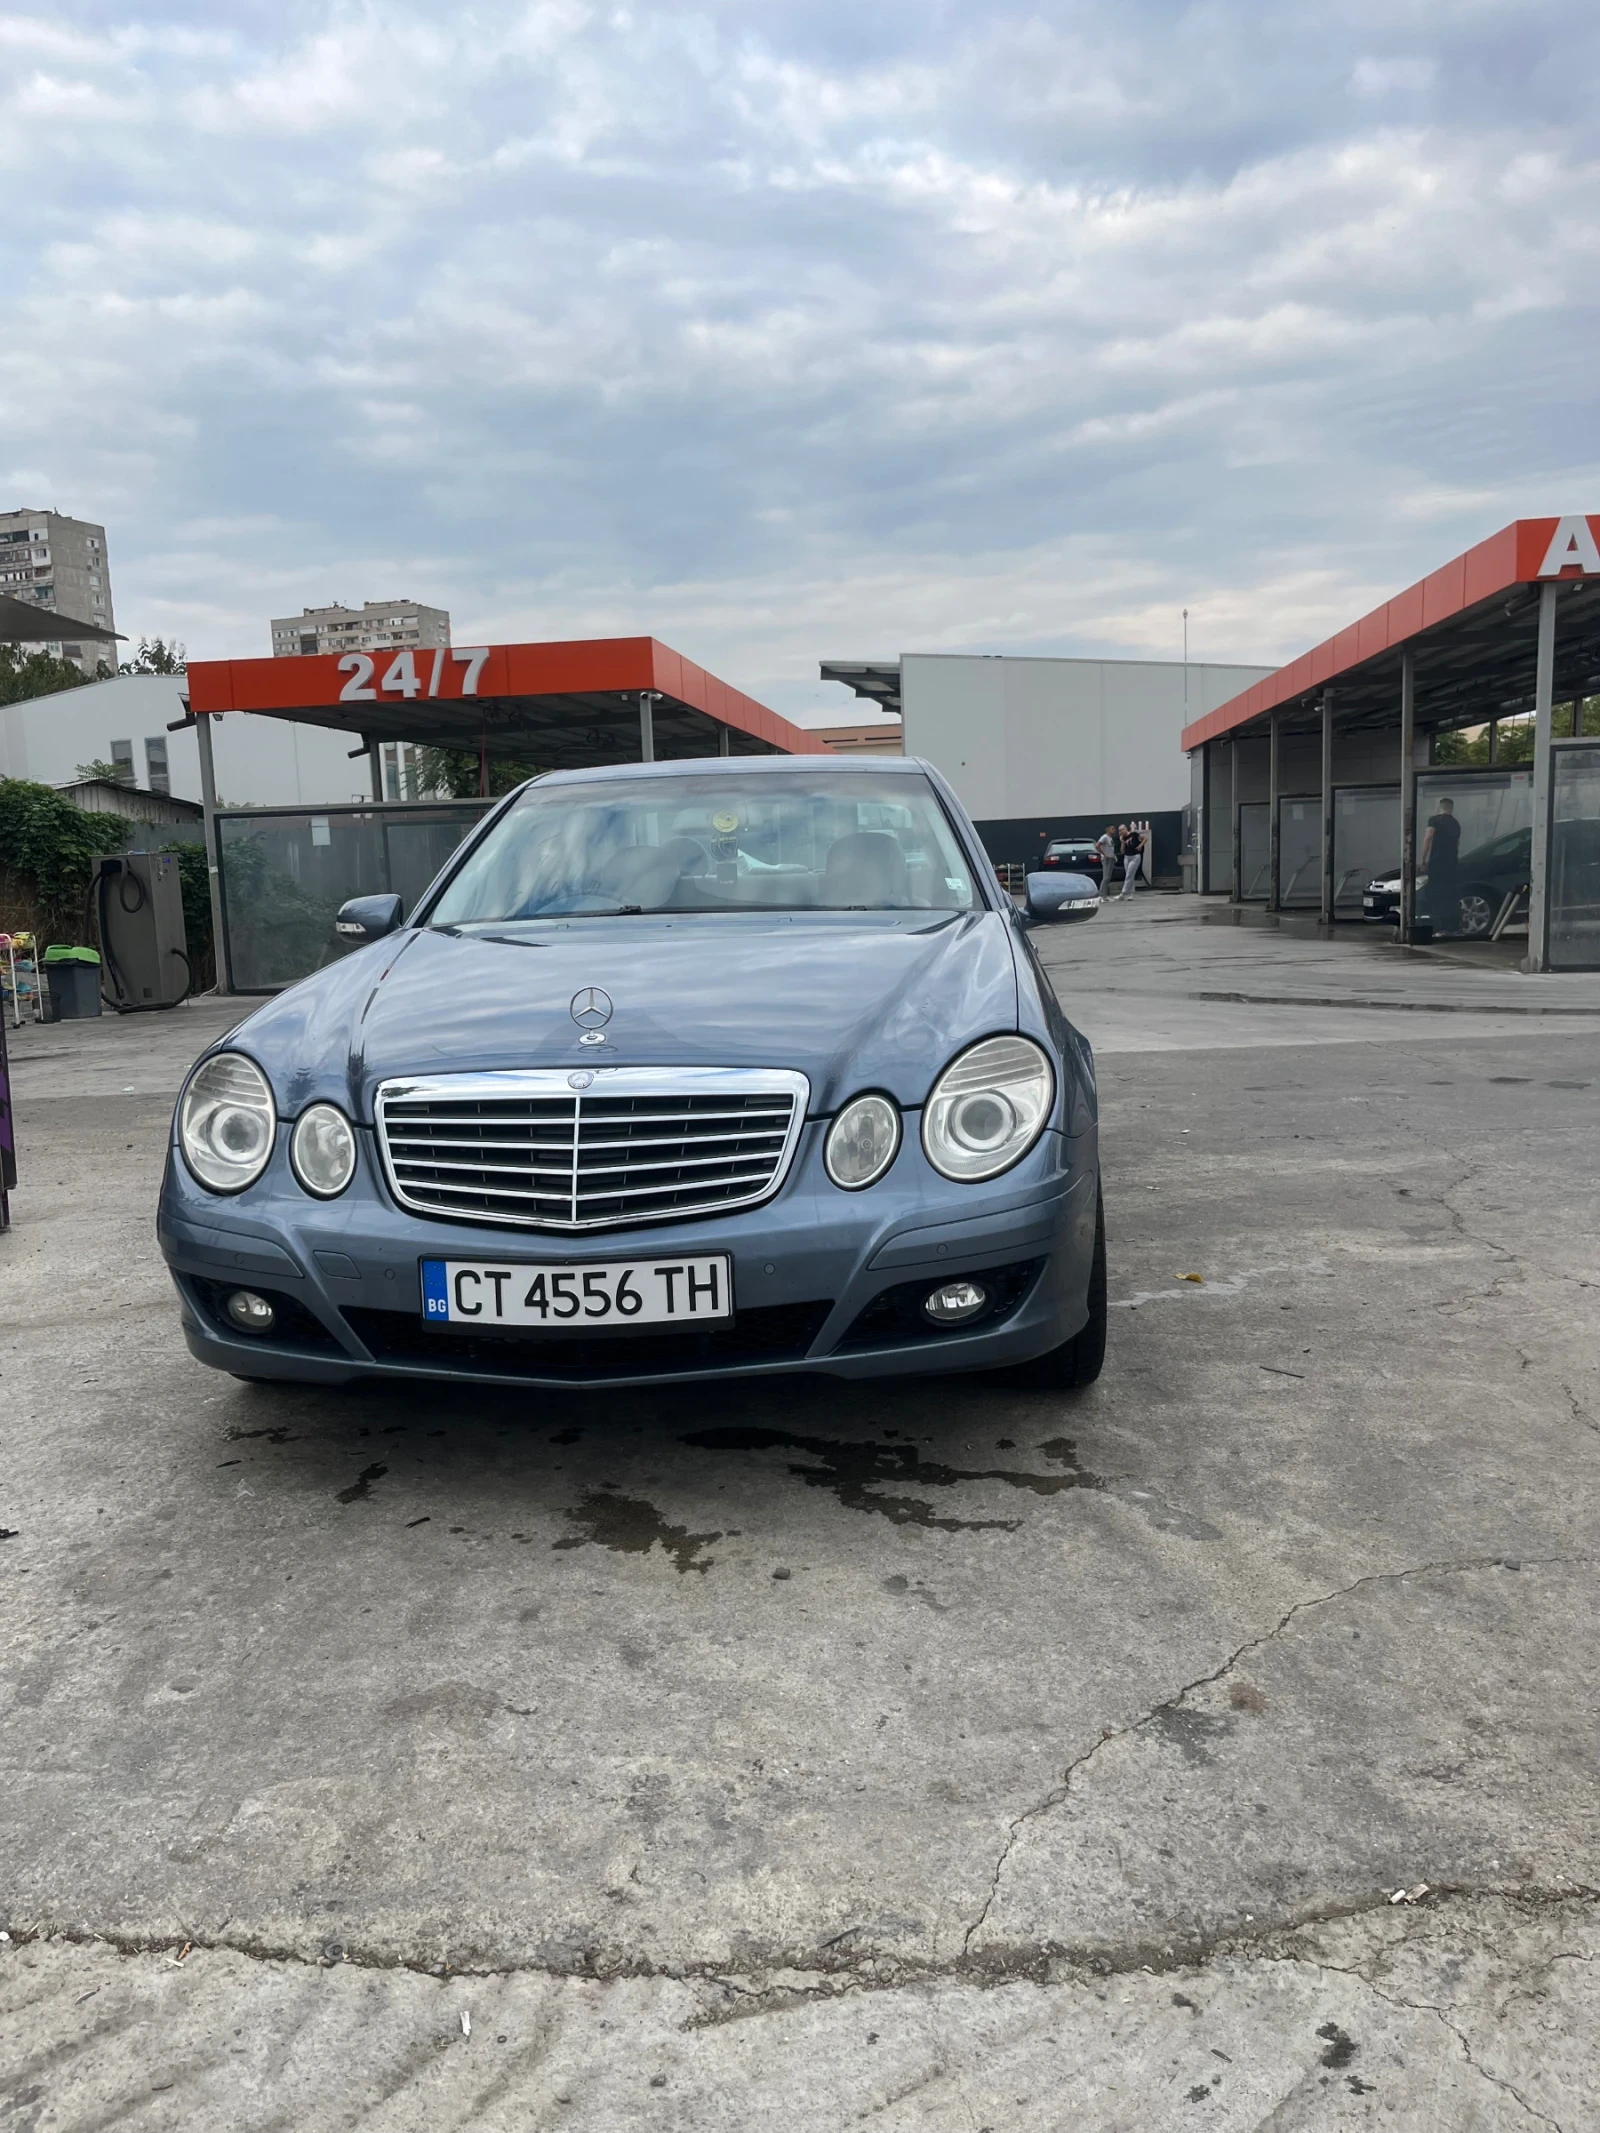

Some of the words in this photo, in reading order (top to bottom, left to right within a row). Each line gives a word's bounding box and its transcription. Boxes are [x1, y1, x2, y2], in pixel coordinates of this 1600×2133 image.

[1536, 514, 1600, 577] A
[337, 648, 490, 702] 24/7
[428, 1298, 447, 1313] BG
[455, 1269, 511, 1317] CT
[524, 1269, 643, 1319] 4556
[654, 1264, 719, 1314] TH
